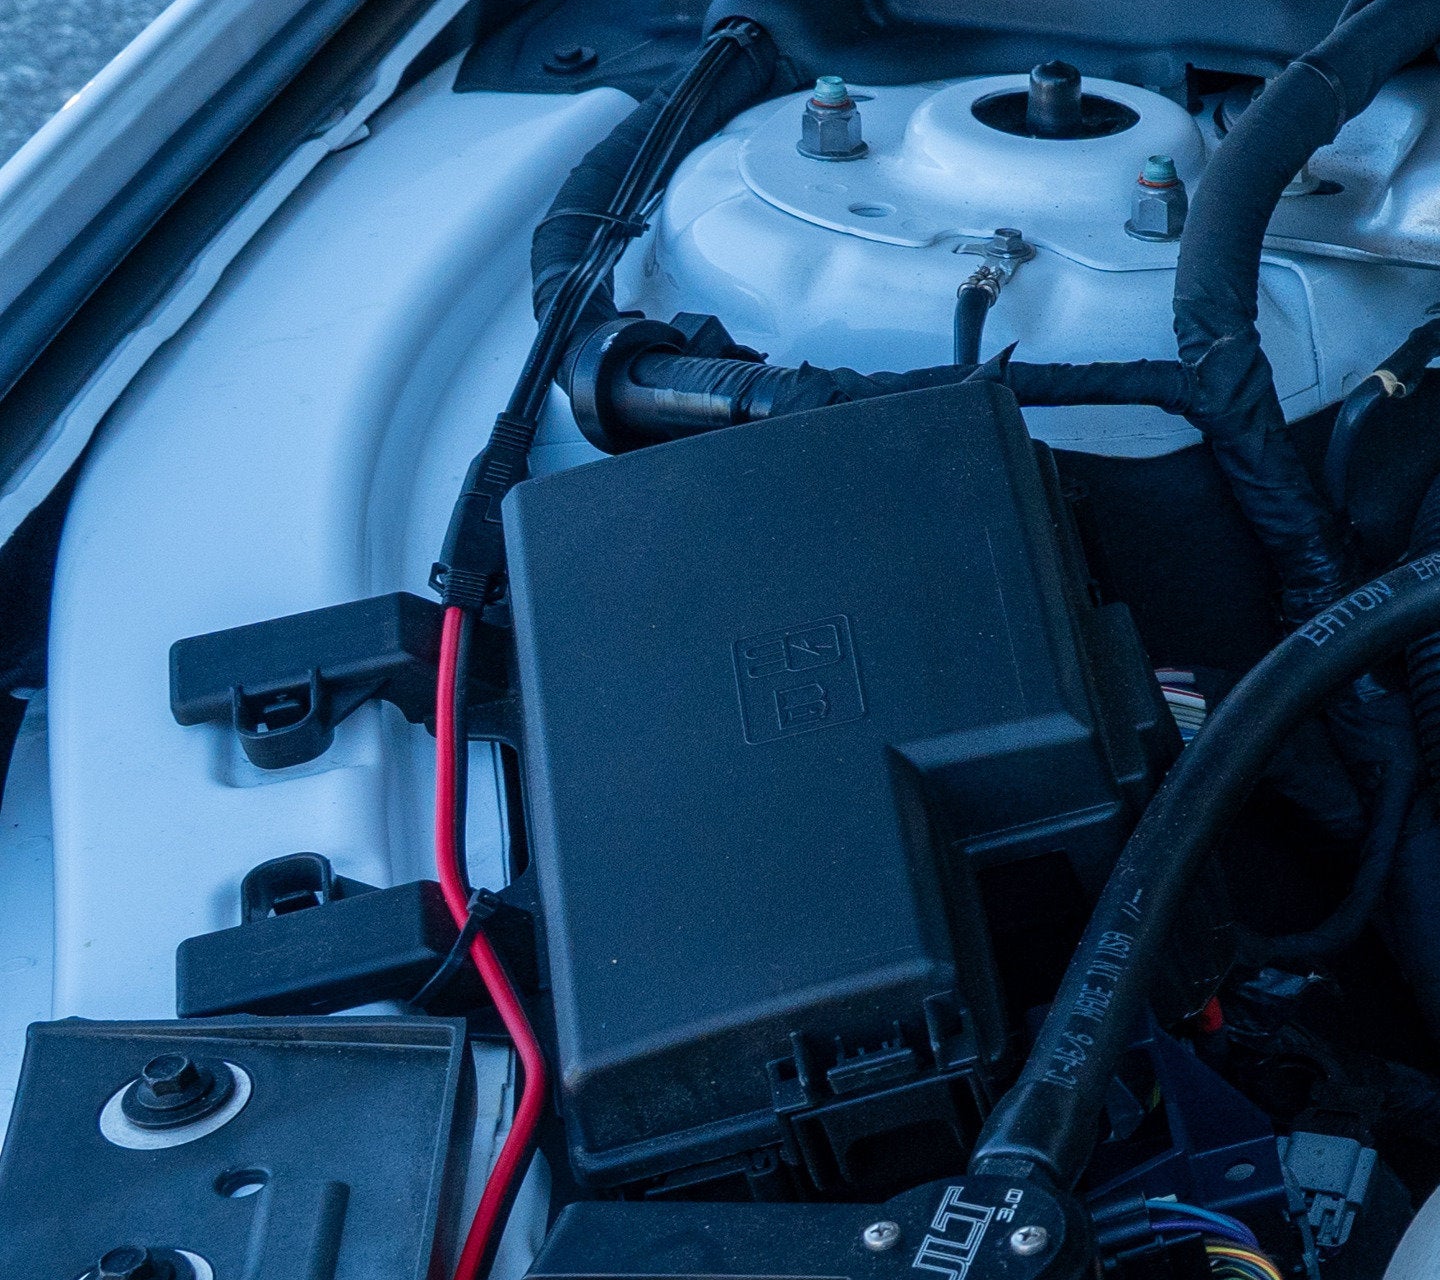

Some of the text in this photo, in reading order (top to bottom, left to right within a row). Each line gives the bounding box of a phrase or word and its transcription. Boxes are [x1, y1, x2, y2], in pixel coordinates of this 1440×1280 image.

[1300, 581, 1394, 648] EATON
[1096, 930, 1135, 959] USA
[1087, 959, 1122, 981] IN
[1073, 982, 1114, 1022] MADE
[994, 1187, 1023, 1224] 3.0
